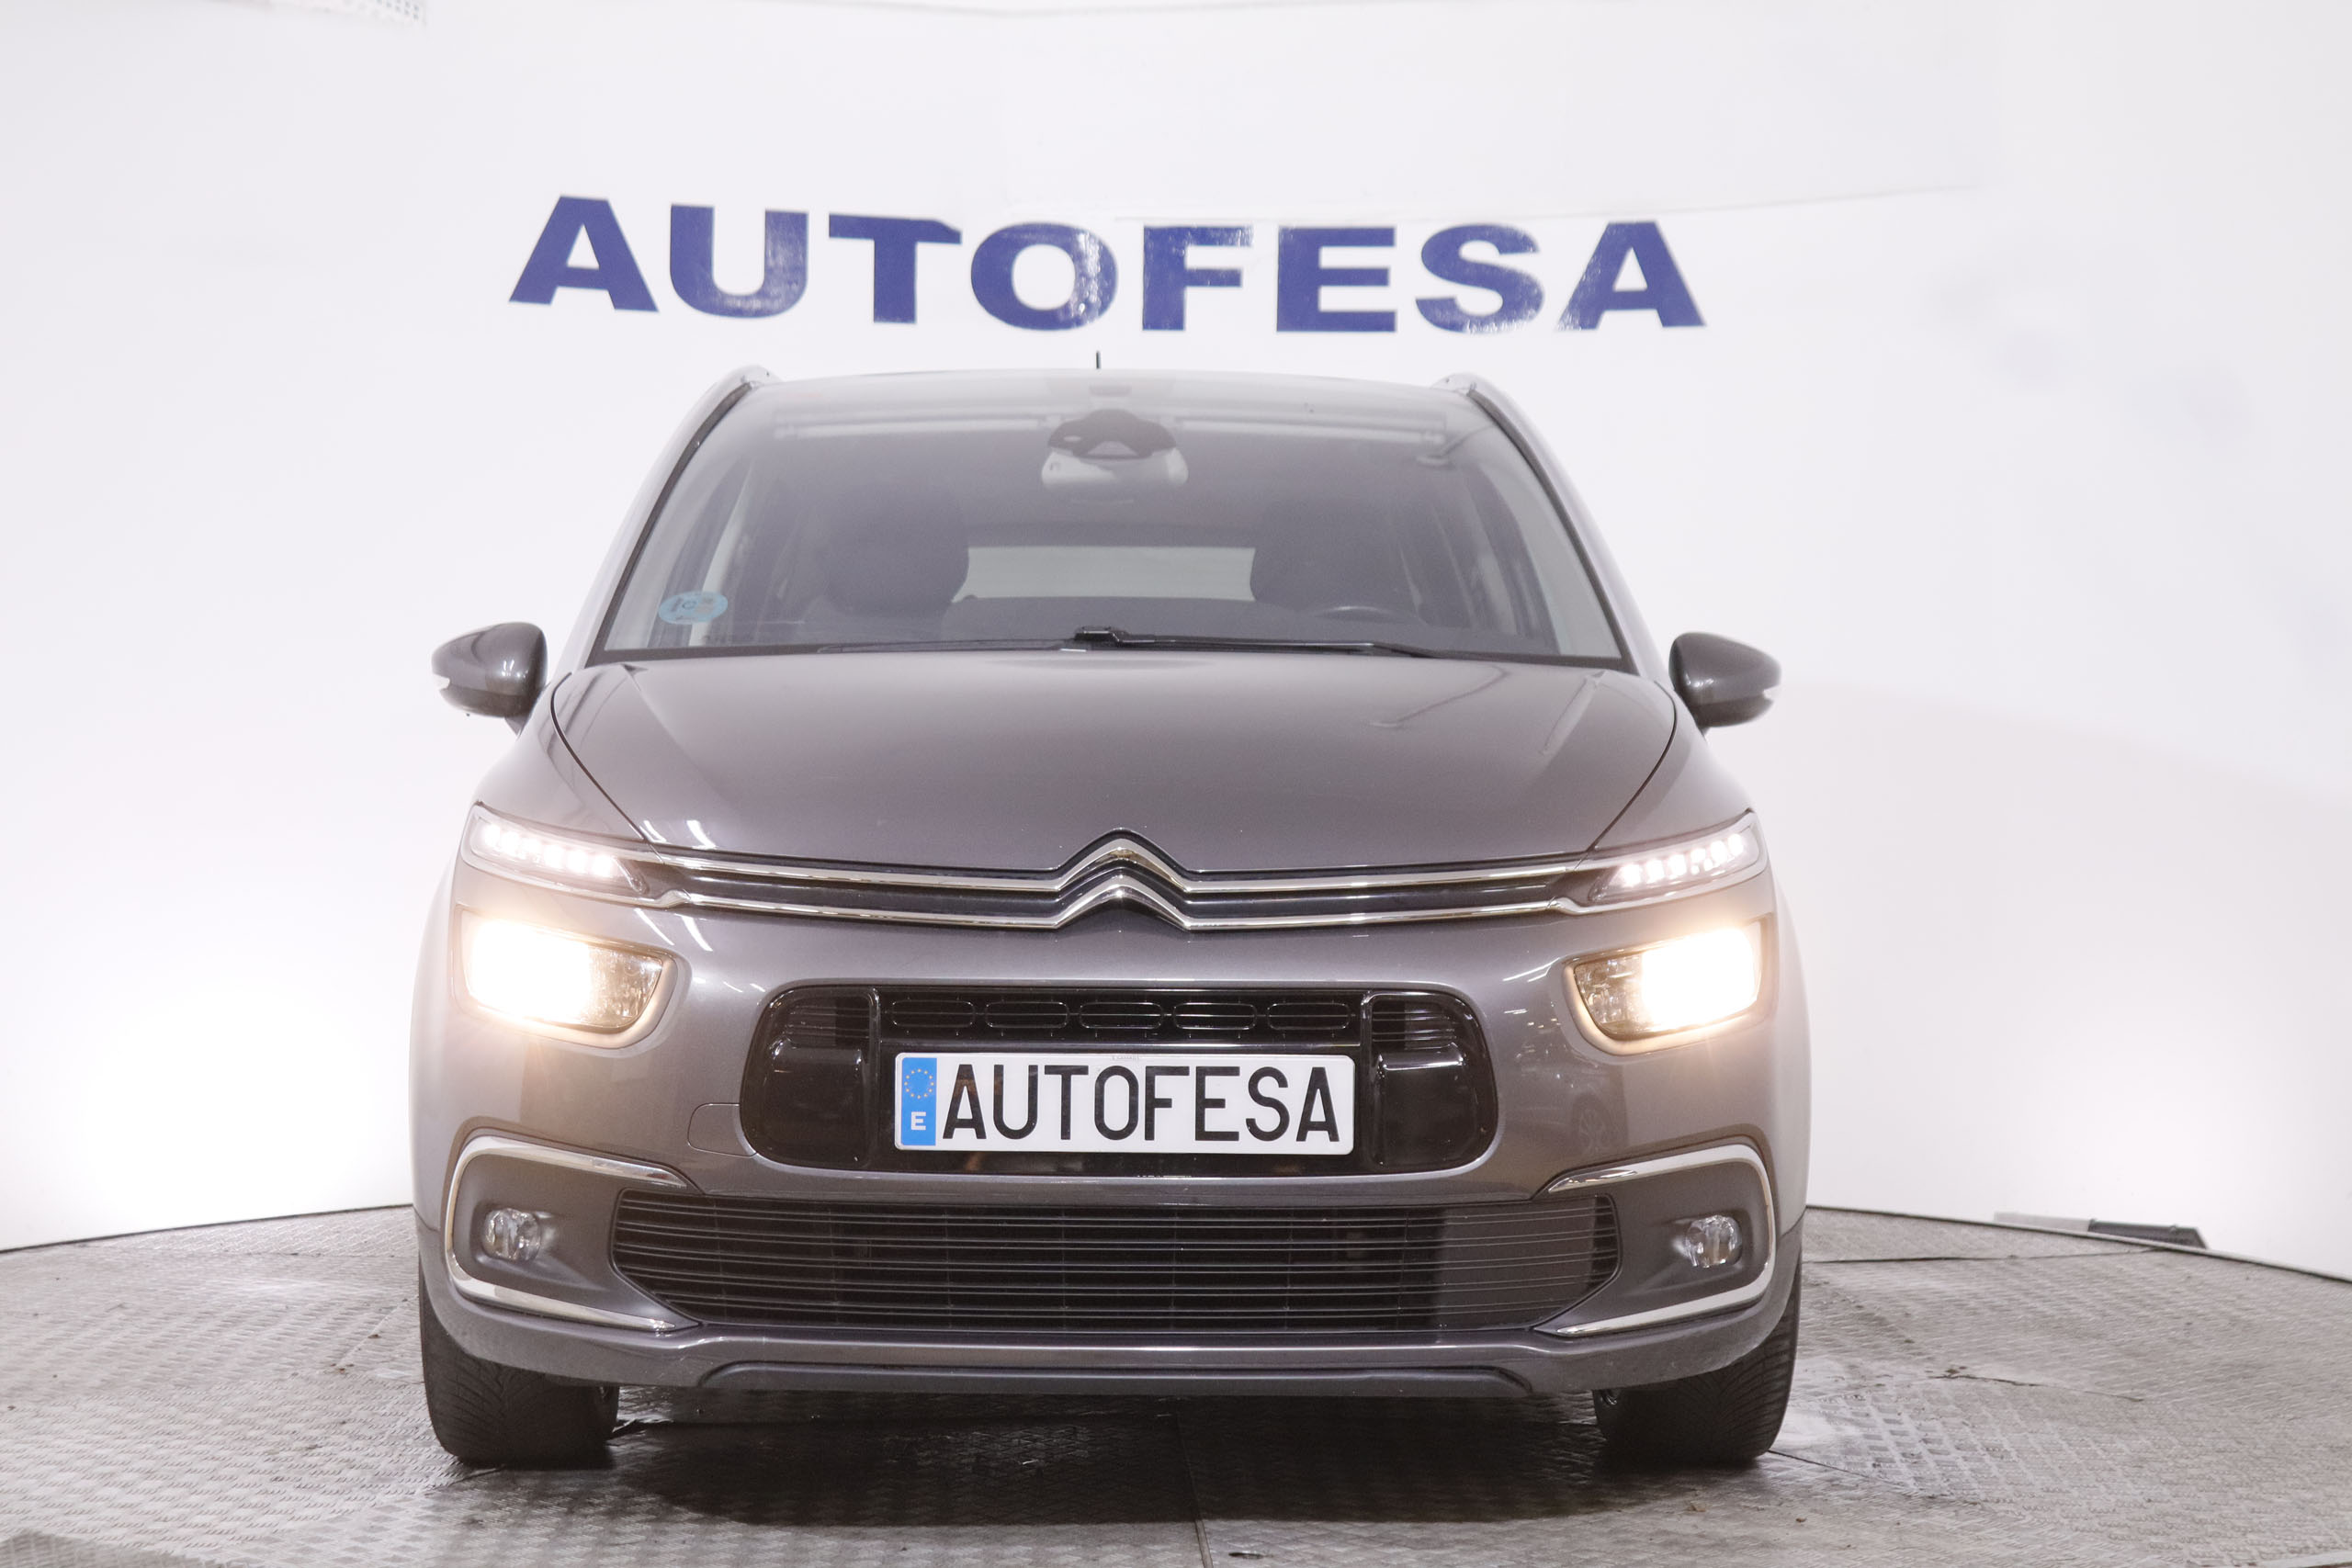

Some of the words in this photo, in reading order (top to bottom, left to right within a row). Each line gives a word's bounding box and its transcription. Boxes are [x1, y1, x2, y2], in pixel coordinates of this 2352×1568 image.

[508, 195, 1707, 334] AUTOFESA
[910, 1111, 927, 1131] E
[942, 1063, 1340, 1142] AUTOFESA
